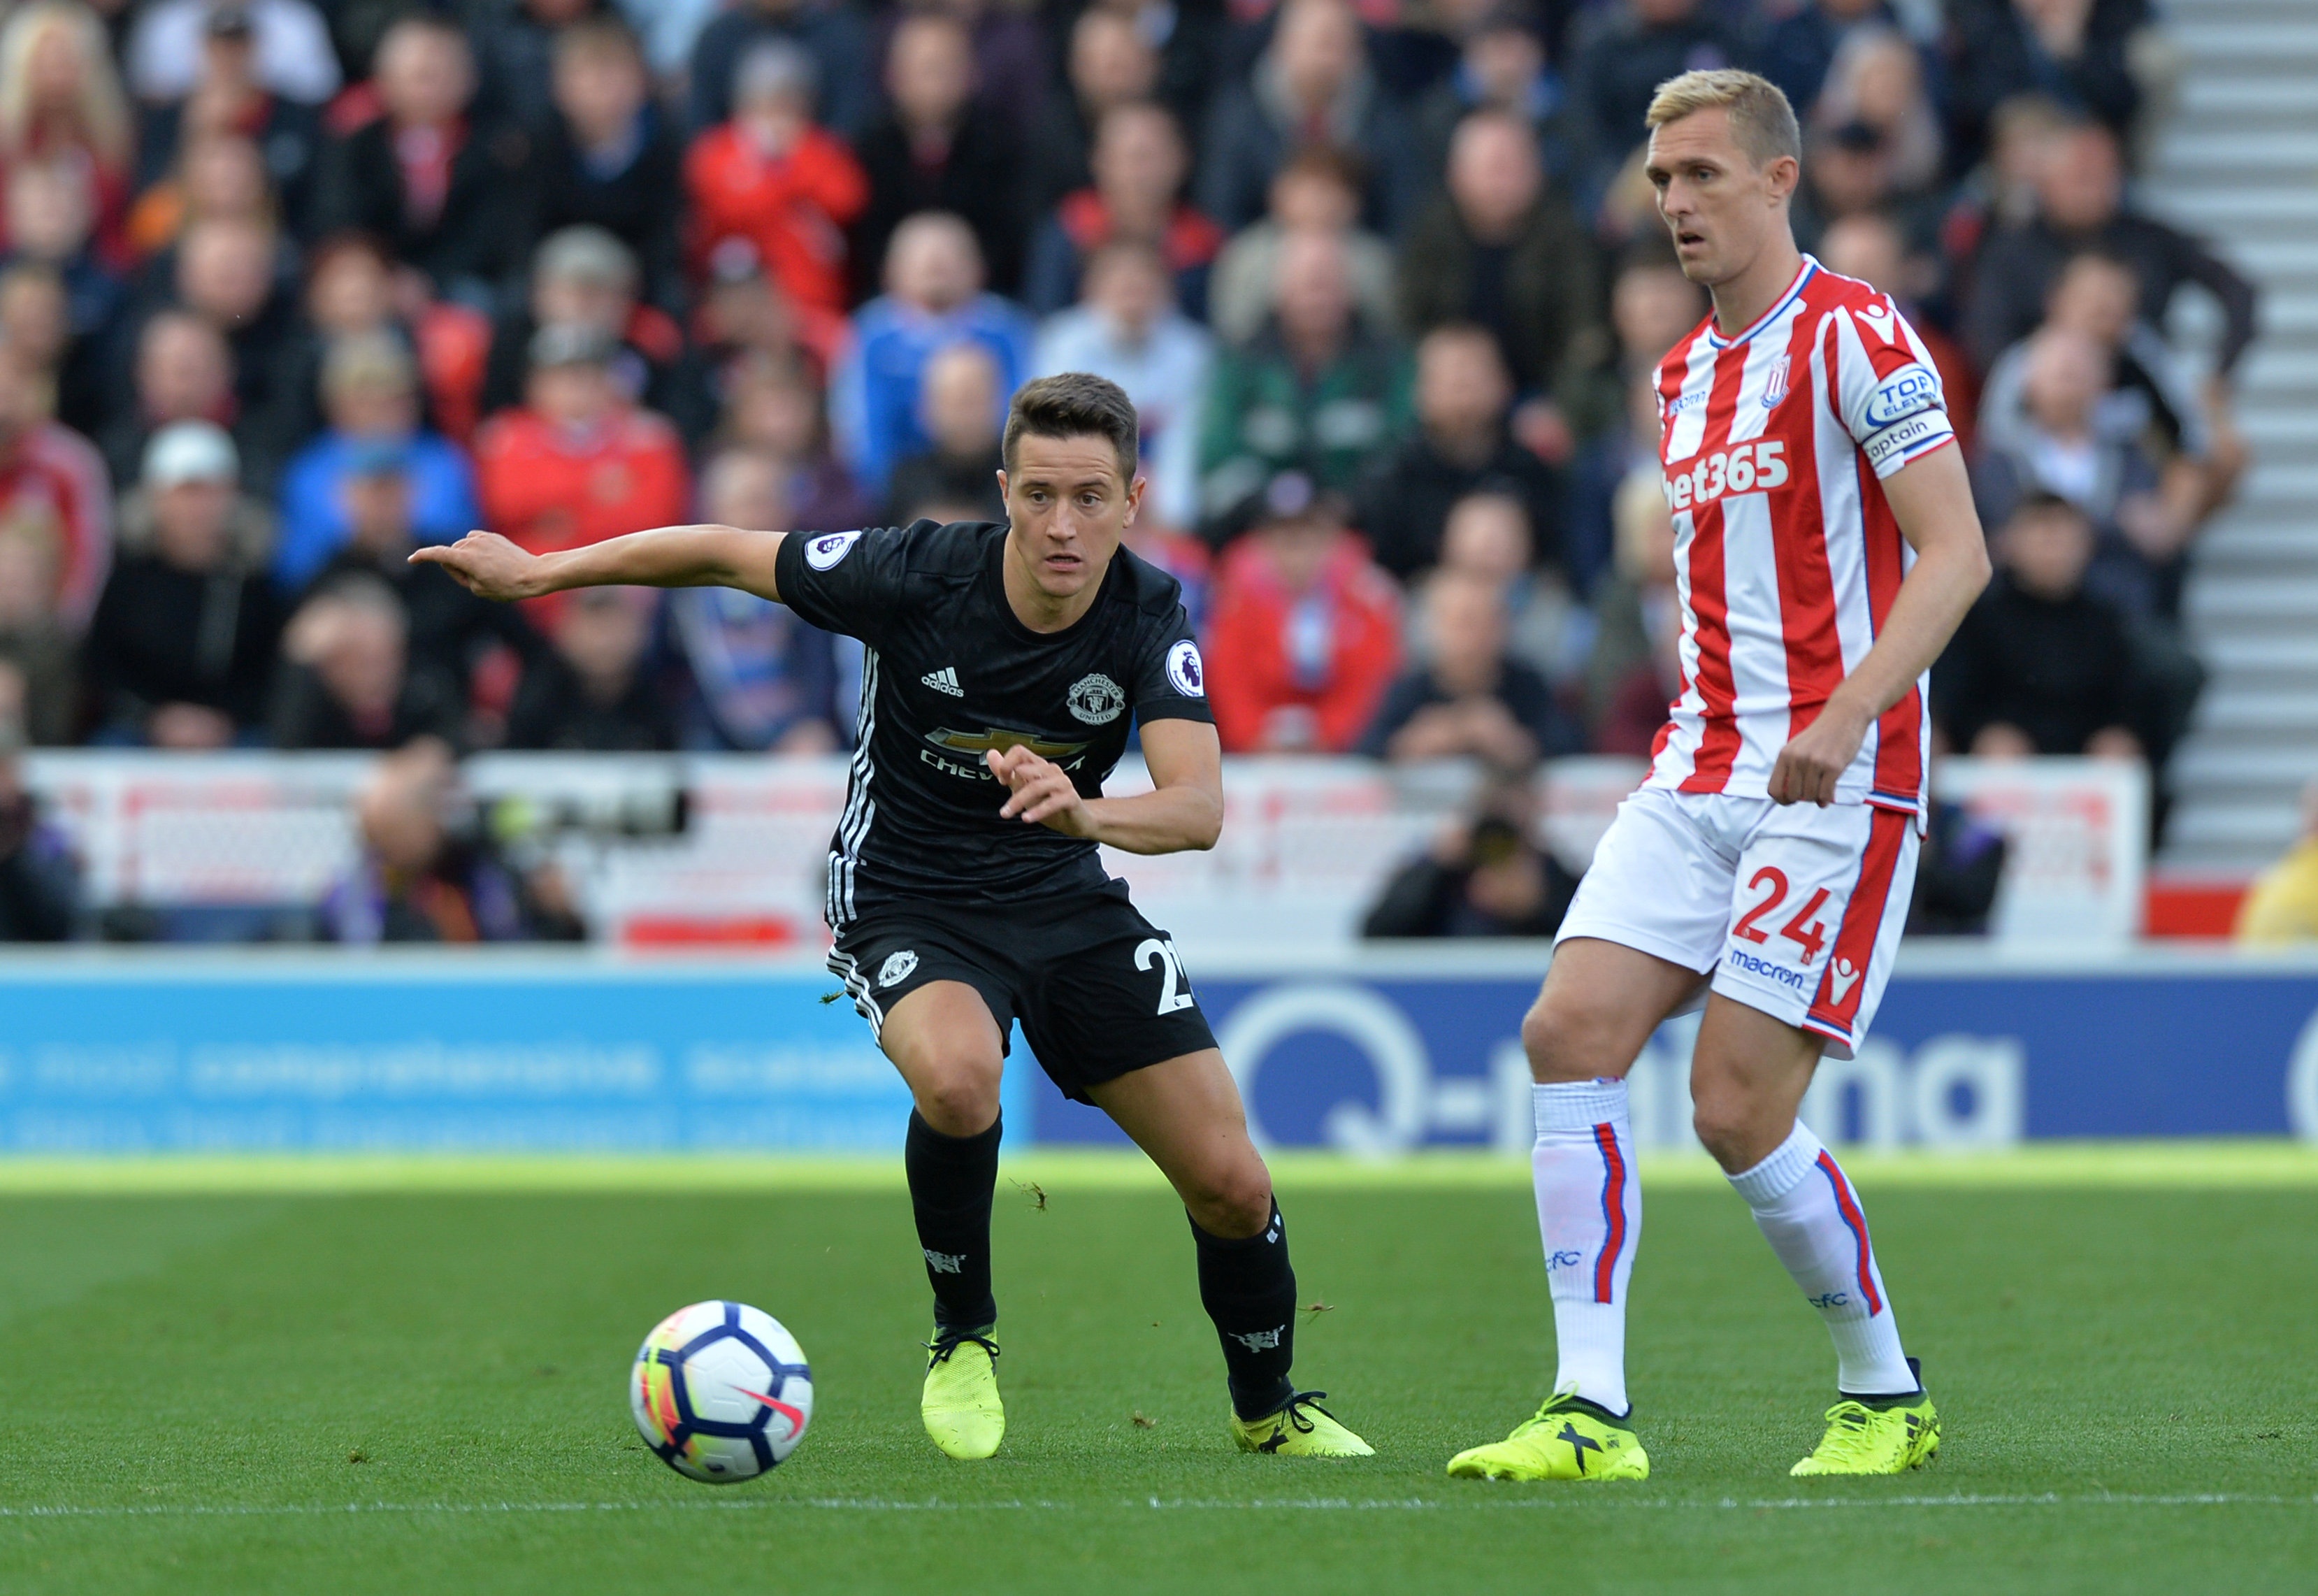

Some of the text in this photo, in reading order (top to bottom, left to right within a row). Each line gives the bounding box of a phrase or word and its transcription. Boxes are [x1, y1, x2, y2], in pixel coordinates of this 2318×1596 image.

[1879, 376, 1927, 403] TOP
[1868, 421, 1928, 456] aptain
[1662, 440, 1790, 511] bet365
[921, 676, 965, 698] adidas
[1074, 677, 1119, 698] MANCHESTER
[1079, 713, 1112, 722] UNITED
[1732, 866, 1831, 967] 24
[1730, 949, 1805, 990] macron
